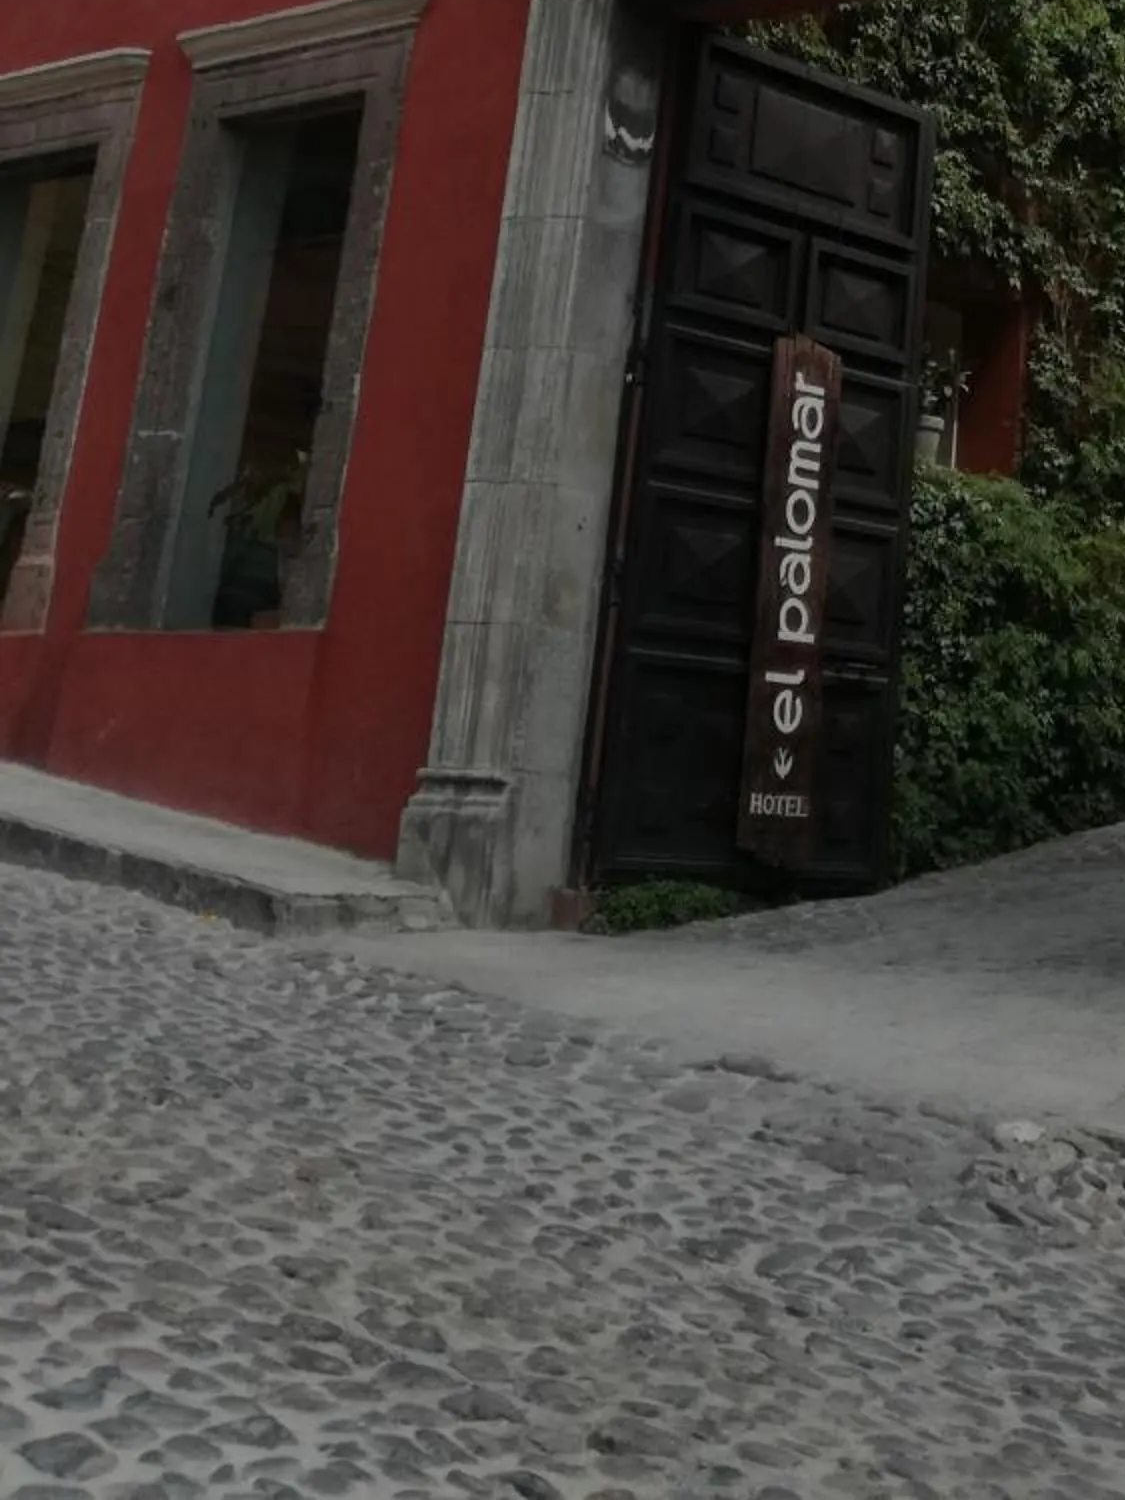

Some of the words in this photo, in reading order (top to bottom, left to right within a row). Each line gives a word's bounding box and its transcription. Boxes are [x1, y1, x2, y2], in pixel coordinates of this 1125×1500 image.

[775, 371, 825, 644] palomar
[765, 669, 805, 734] el
[749, 792, 809, 817] HOTEL
